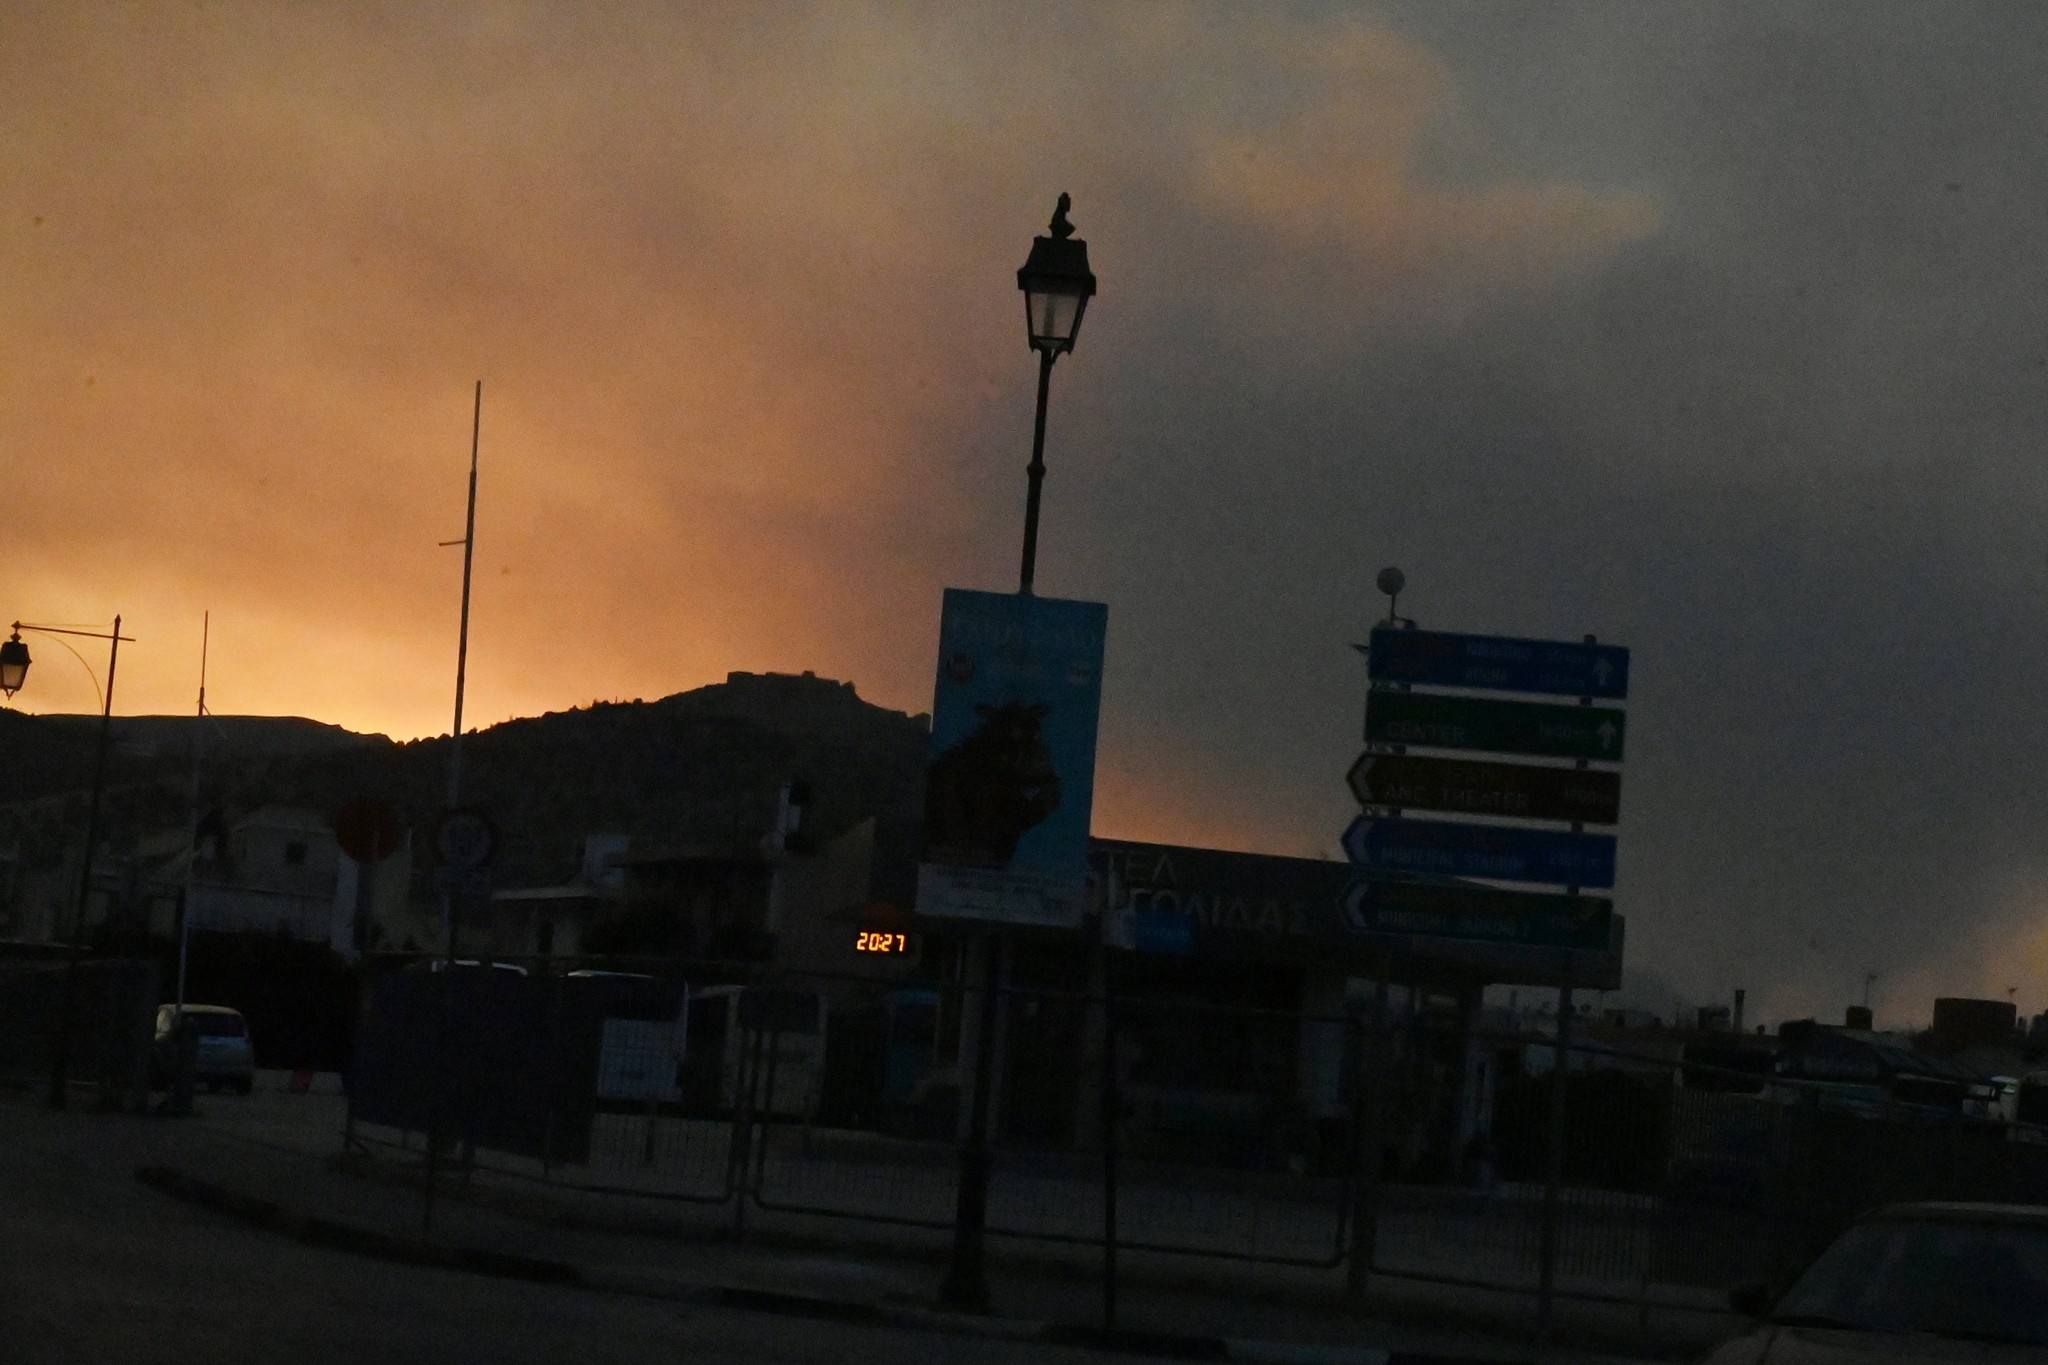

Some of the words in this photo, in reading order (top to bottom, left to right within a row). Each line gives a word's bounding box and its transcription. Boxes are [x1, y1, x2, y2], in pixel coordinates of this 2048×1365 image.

[1387, 720, 1466, 742] CENTER
[1441, 788, 1530, 810] THEATER
[1380, 846, 1455, 868] MUNICIPAL
[856, 931, 906, 953] 20:27
